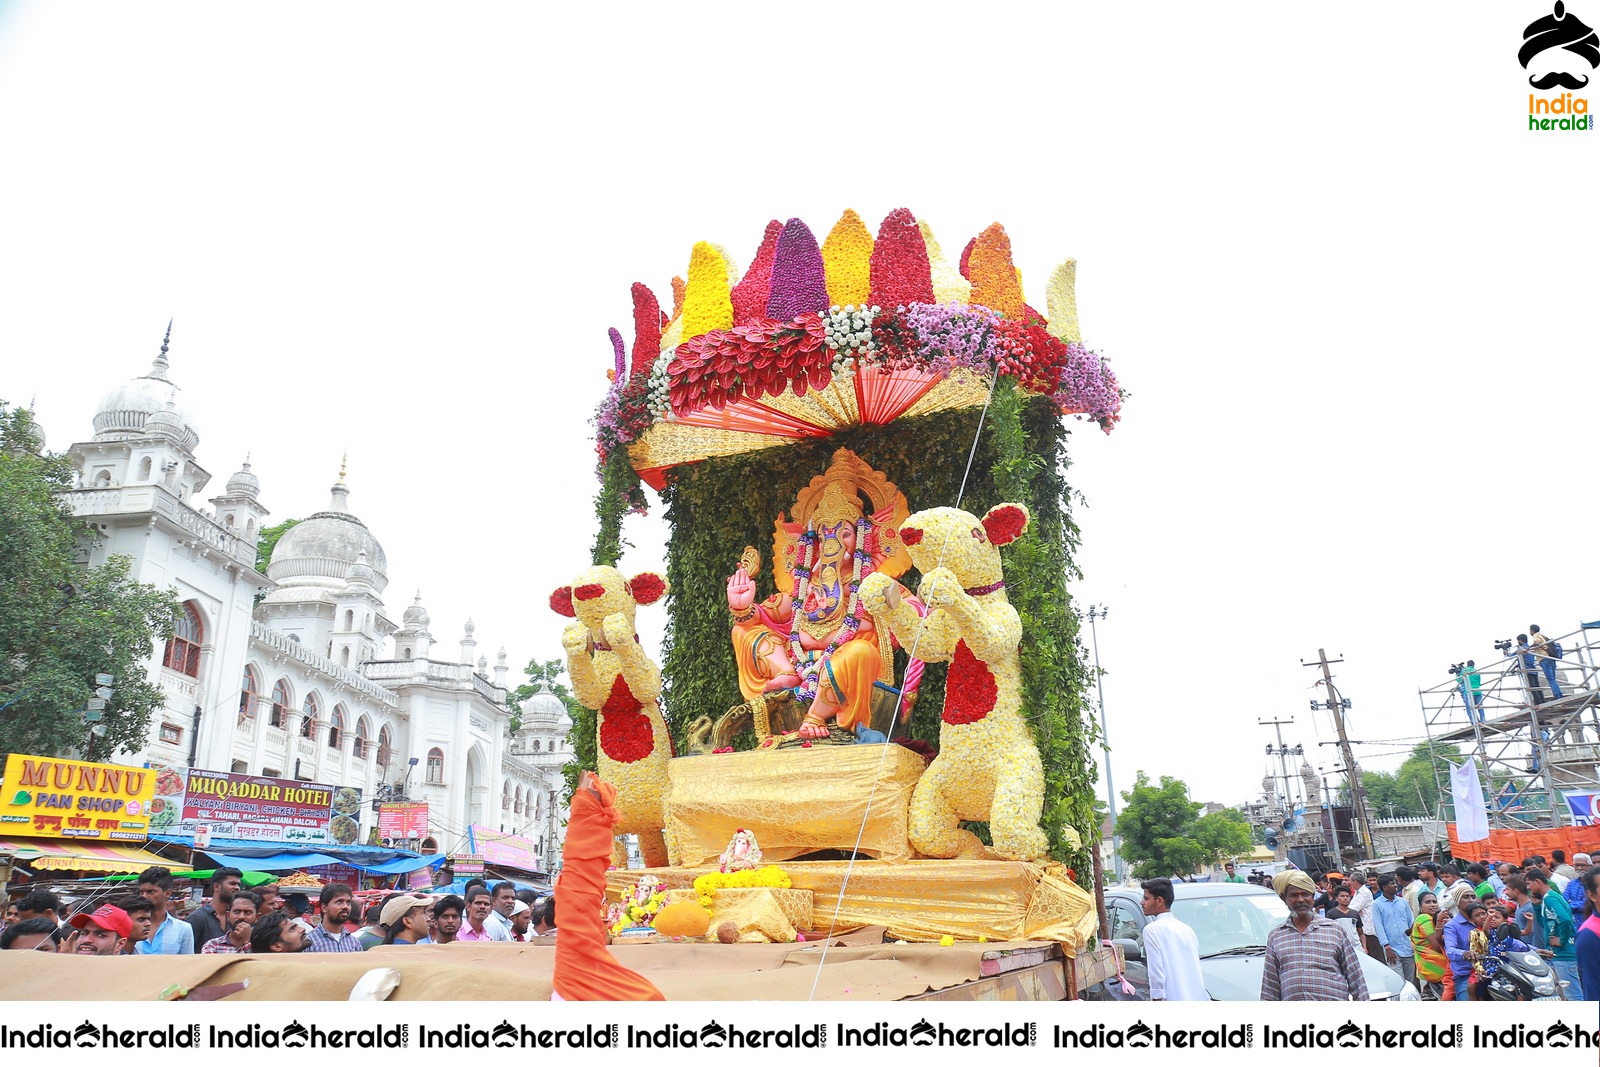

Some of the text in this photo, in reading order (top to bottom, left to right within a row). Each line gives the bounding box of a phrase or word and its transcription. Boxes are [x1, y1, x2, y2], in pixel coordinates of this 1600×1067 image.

[19, 760, 146, 795] MUNNU
[188, 777, 330, 806] MUQADDAR HOTEL
[36, 792, 73, 809] PAN
[77, 795, 125, 813] SHOP
[186, 798, 224, 810] KALYANI
[270, 816, 293, 825] KHANA
[294, 818, 318, 827] DALCHA
[37, 857, 76, 867] MUNNU
[79, 860, 98, 869] PAN
[101, 863, 128, 871] SHOP
